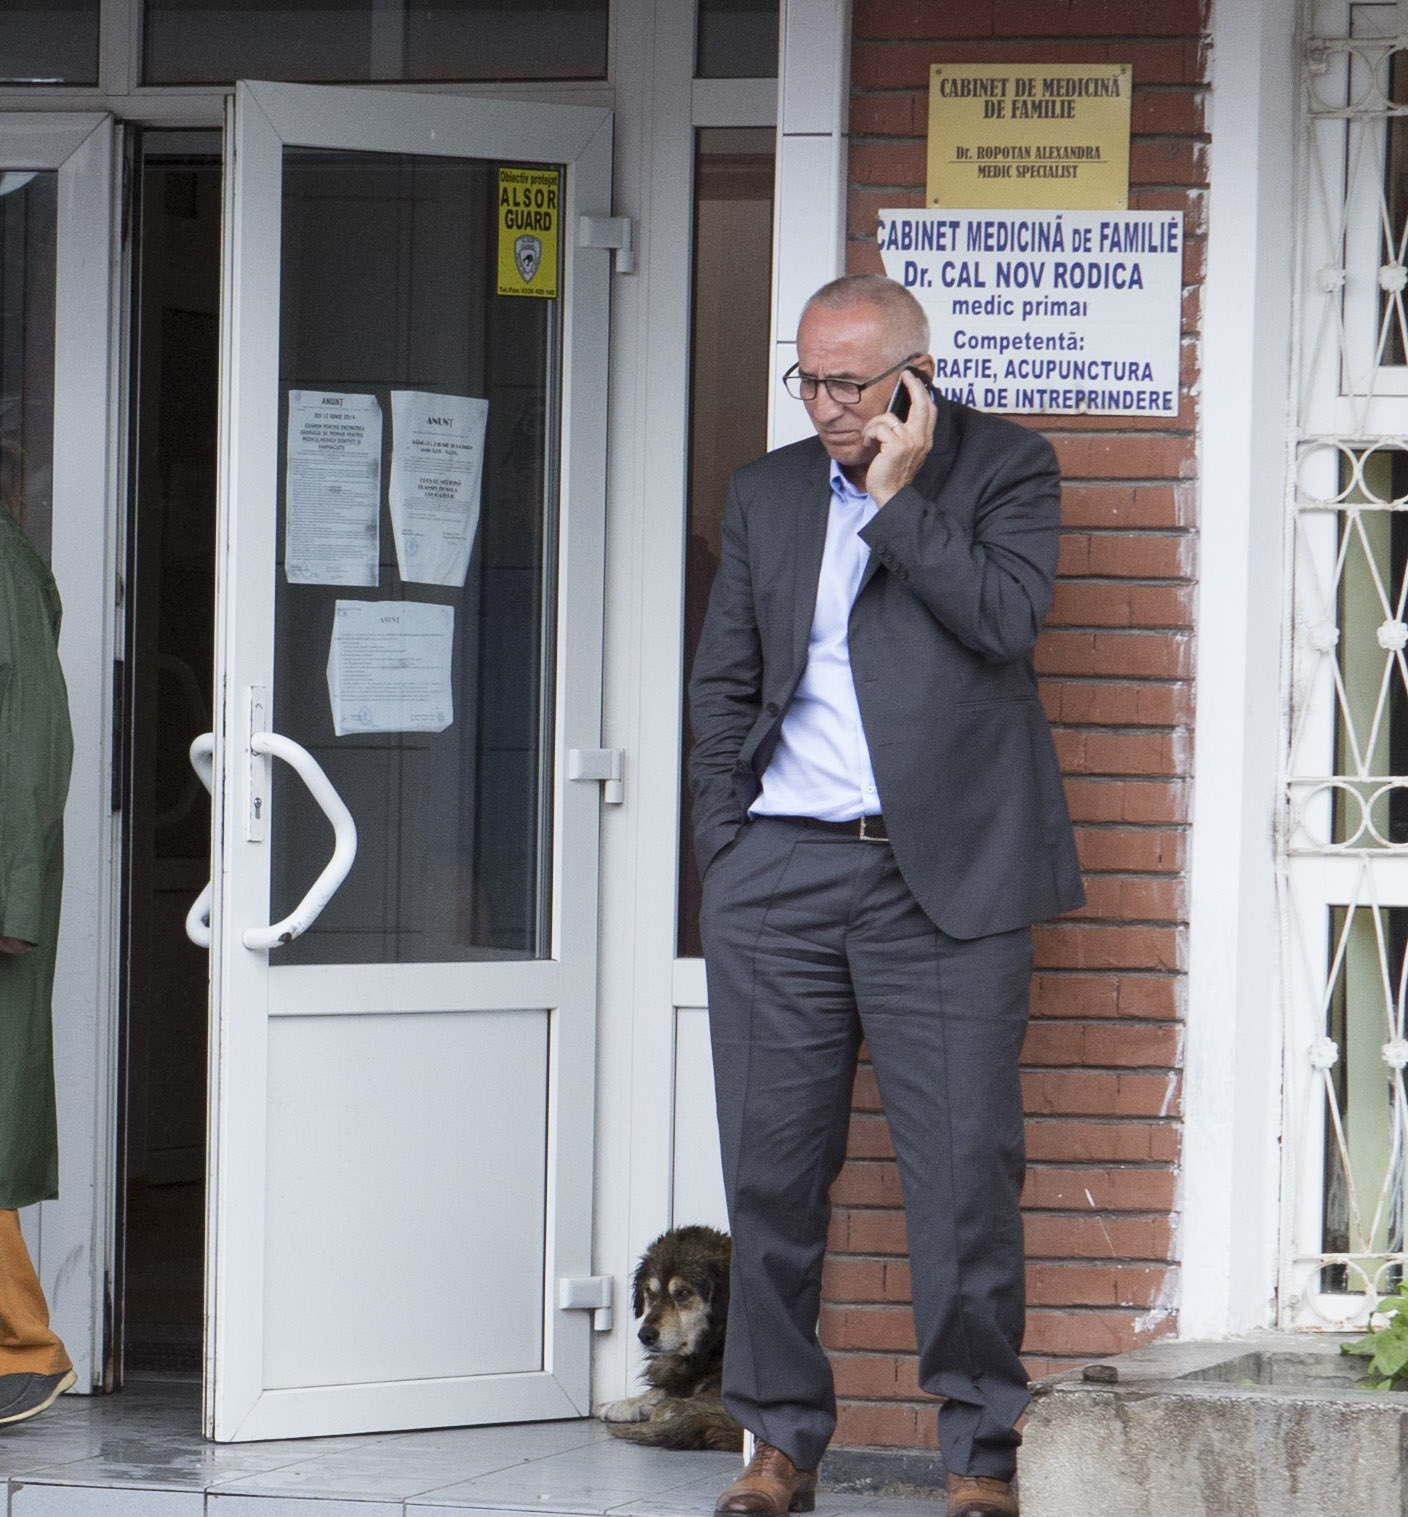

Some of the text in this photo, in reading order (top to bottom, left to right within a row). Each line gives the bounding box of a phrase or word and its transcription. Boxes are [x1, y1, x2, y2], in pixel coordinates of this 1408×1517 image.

[940, 78, 1009, 97] CABINET
[1015, 78, 1036, 97] DE
[983, 99, 1075, 119] DE FAMILIE
[956, 146, 1101, 160] Dr. ROPOTAN ALEXANDRA
[977, 165, 1078, 178] MEDIC SPECIALIST
[500, 187, 556, 210] ALSOR
[504, 209, 552, 232] GUARD
[877, 219, 960, 251] CABINET
[1072, 228, 1092, 252] DE
[1100, 220, 1178, 253] FAMILIE
[904, 260, 932, 288] Dr.
[1054, 262, 1144, 289] RODICA
[952, 295, 1014, 316] medic
[937, 358, 1153, 384] RAFIE, ACUPUNCTURA
[984, 388, 1008, 408] DE
[1015, 388, 1174, 411] INTREPRINDERE
